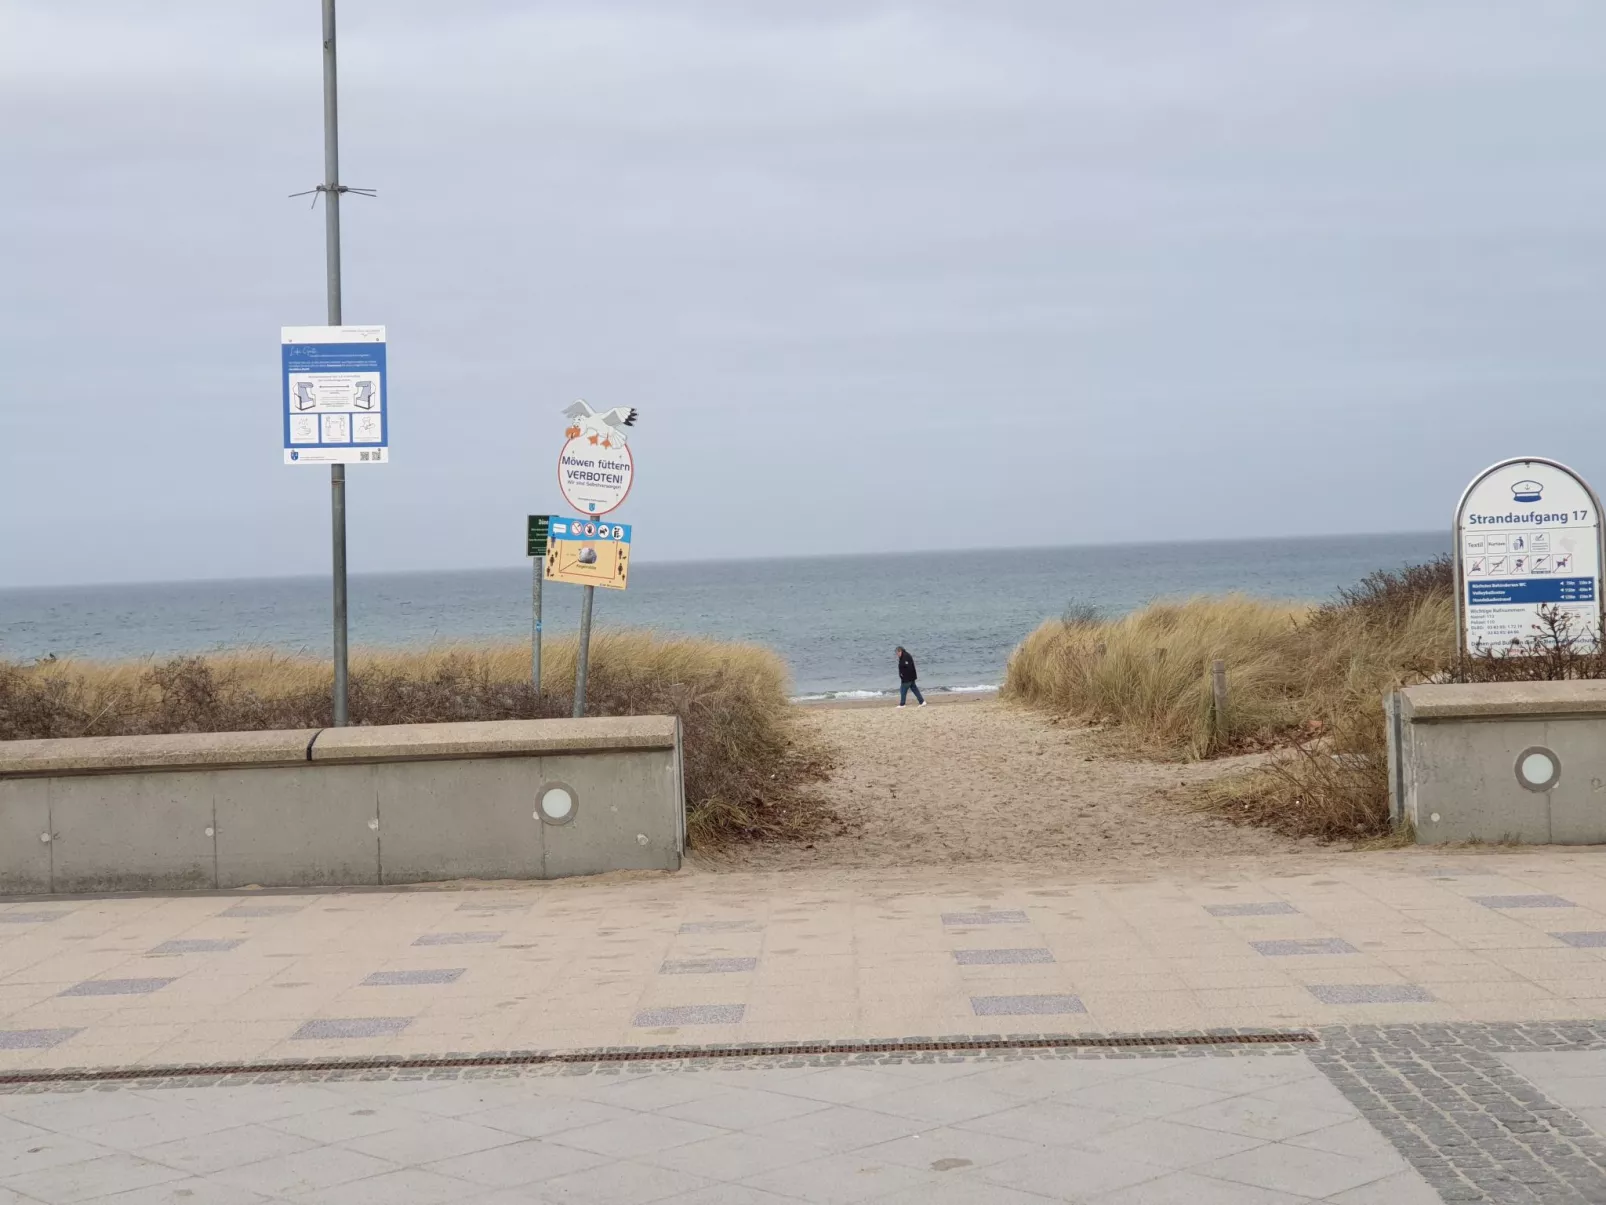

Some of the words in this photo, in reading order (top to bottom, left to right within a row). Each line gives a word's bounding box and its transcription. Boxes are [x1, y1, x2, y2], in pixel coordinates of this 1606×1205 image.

[562, 456, 594, 468] Möwen
[598, 459, 630, 471] füttern
[567, 470, 623, 484] VERBOTEN!
[1469, 512, 1568, 525] Strandaufgang
[1572, 510, 1588, 521] 17
